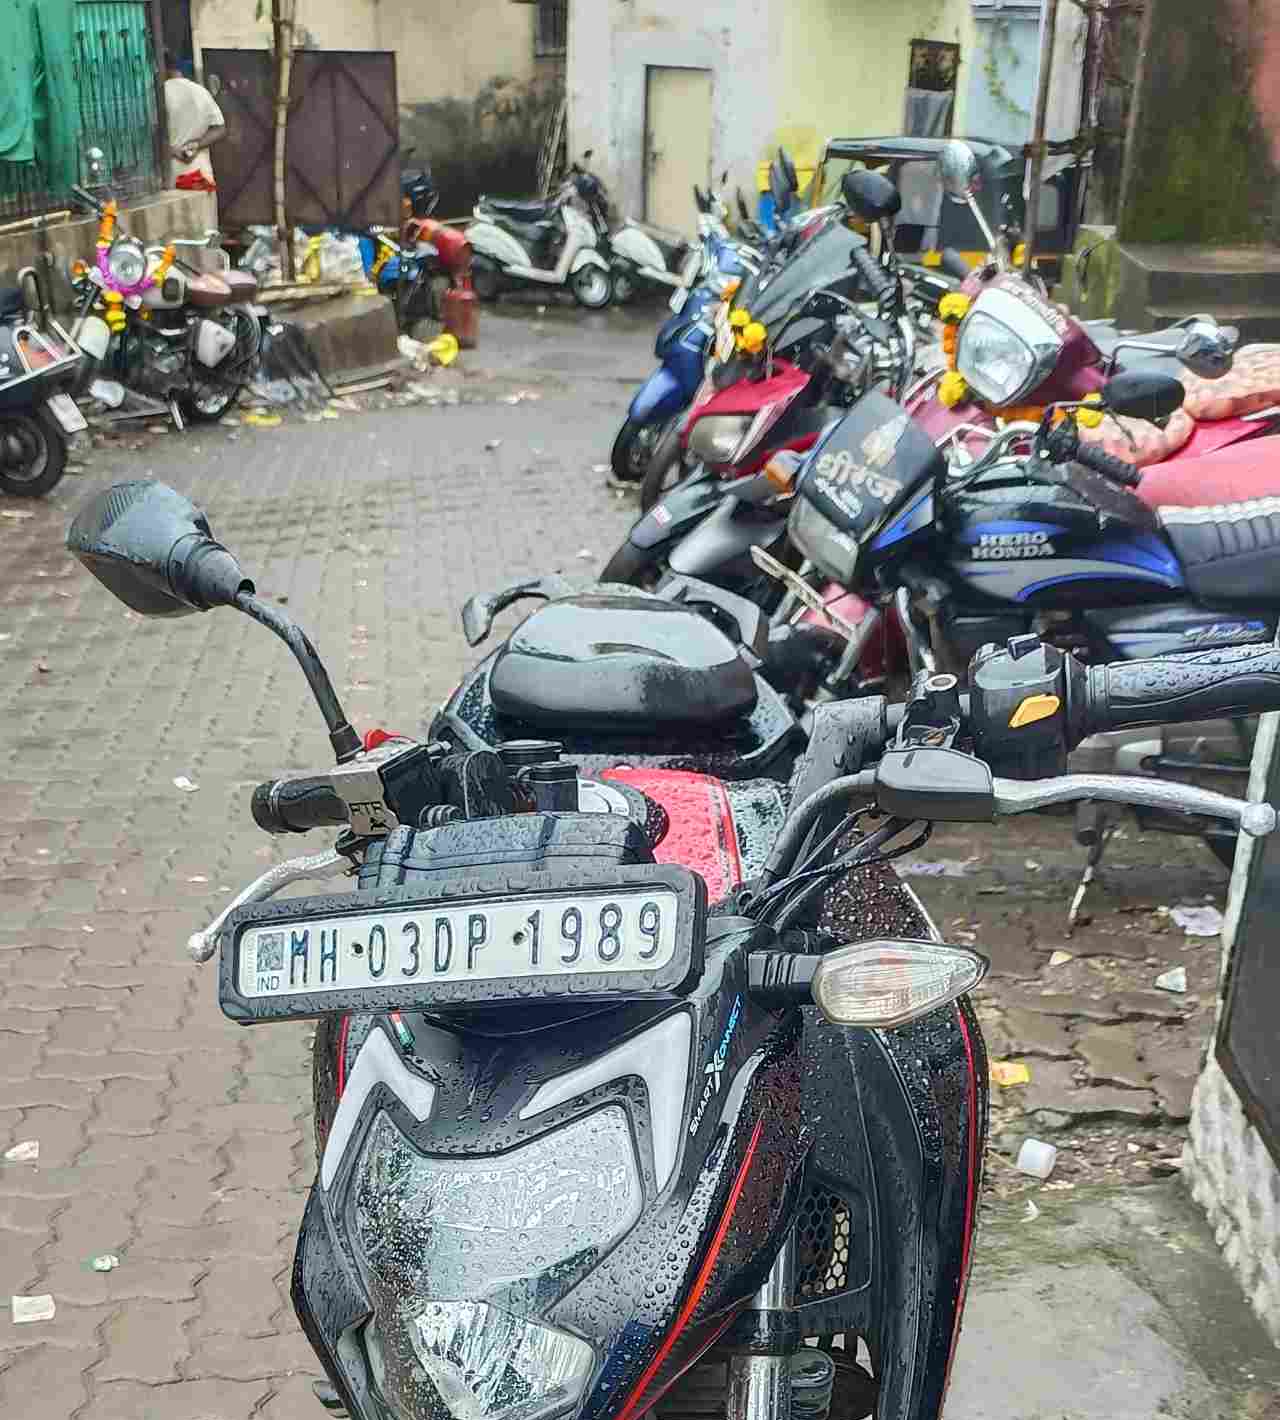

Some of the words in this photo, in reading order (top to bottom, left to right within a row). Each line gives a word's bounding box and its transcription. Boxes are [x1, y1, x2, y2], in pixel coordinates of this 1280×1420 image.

[980, 532, 1049, 546] HERO
[971, 544, 1056, 559] HONDA
[290, 929, 339, 985] MH
[527, 901, 662, 965] 1989
[256, 975, 280, 992] IND
